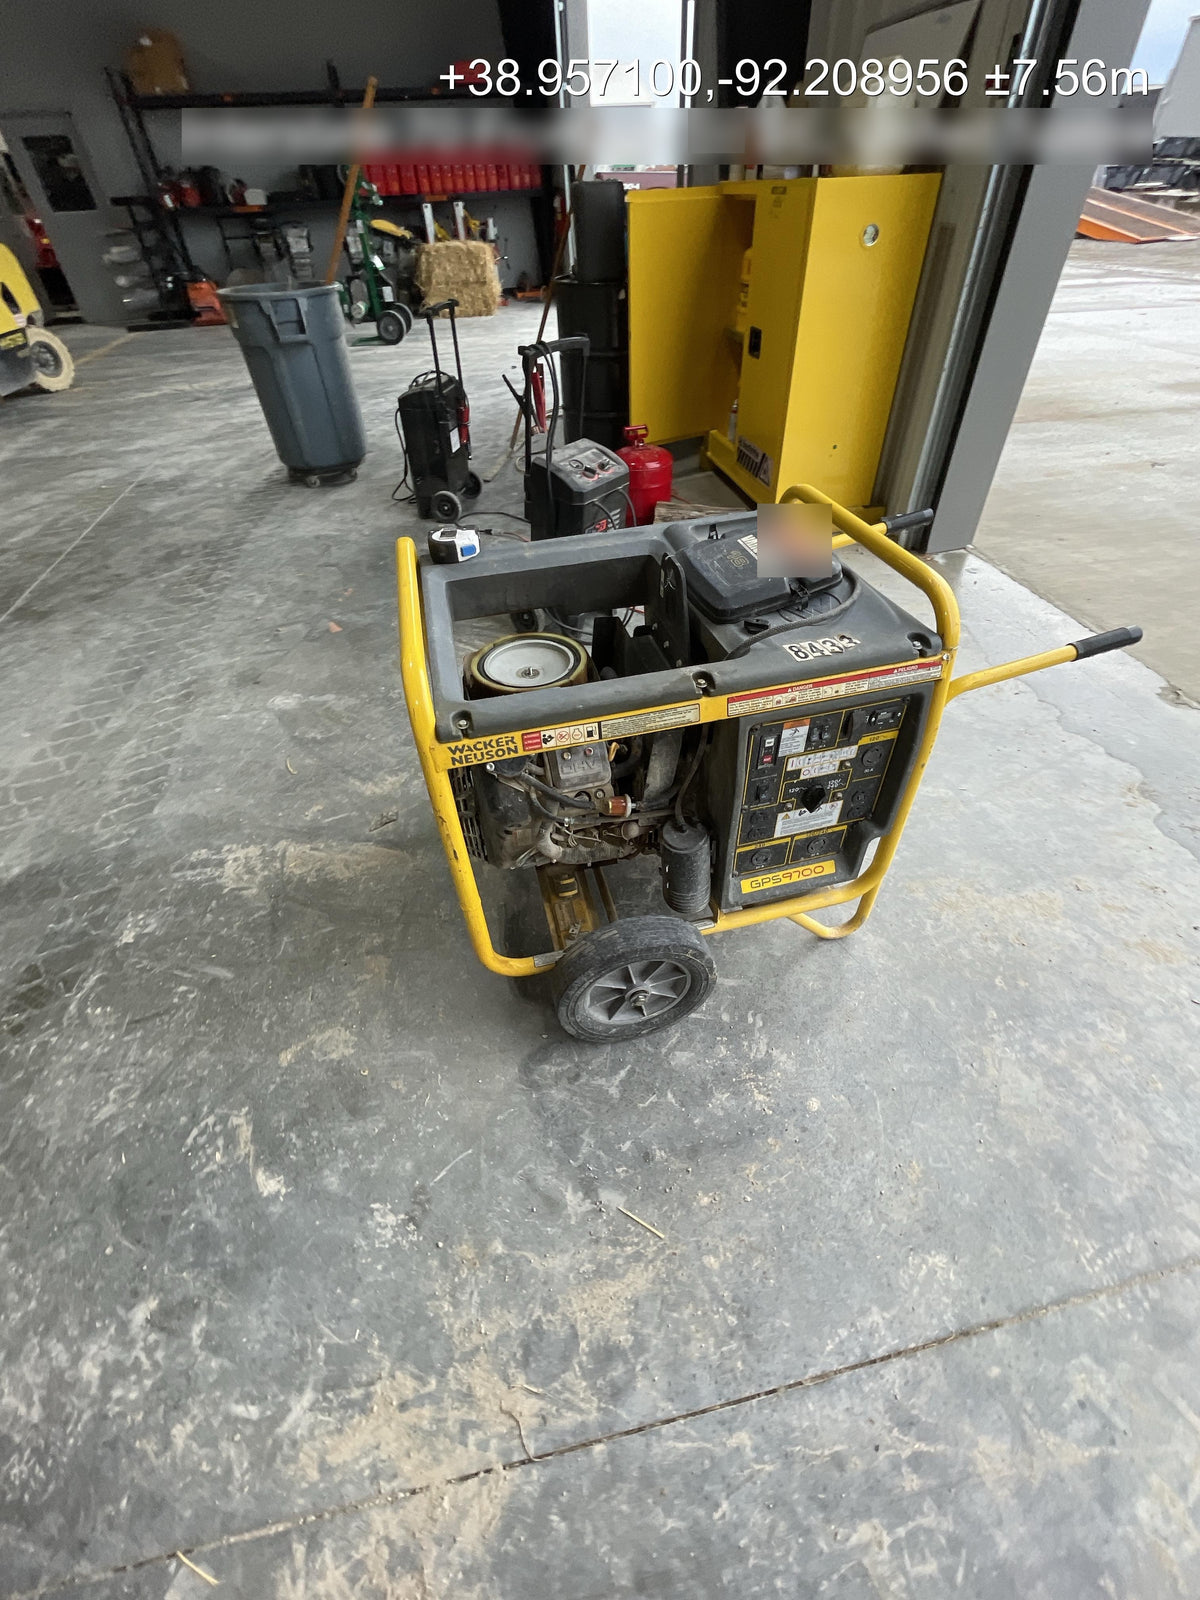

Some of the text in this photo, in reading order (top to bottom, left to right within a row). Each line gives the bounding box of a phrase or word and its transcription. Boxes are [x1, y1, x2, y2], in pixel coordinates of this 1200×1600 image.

[792, 684, 813, 692] DANGER
[447, 735, 518, 756] WACKER
[450, 745, 519, 766] NEUSON
[750, 865, 825, 889] GPS9700
